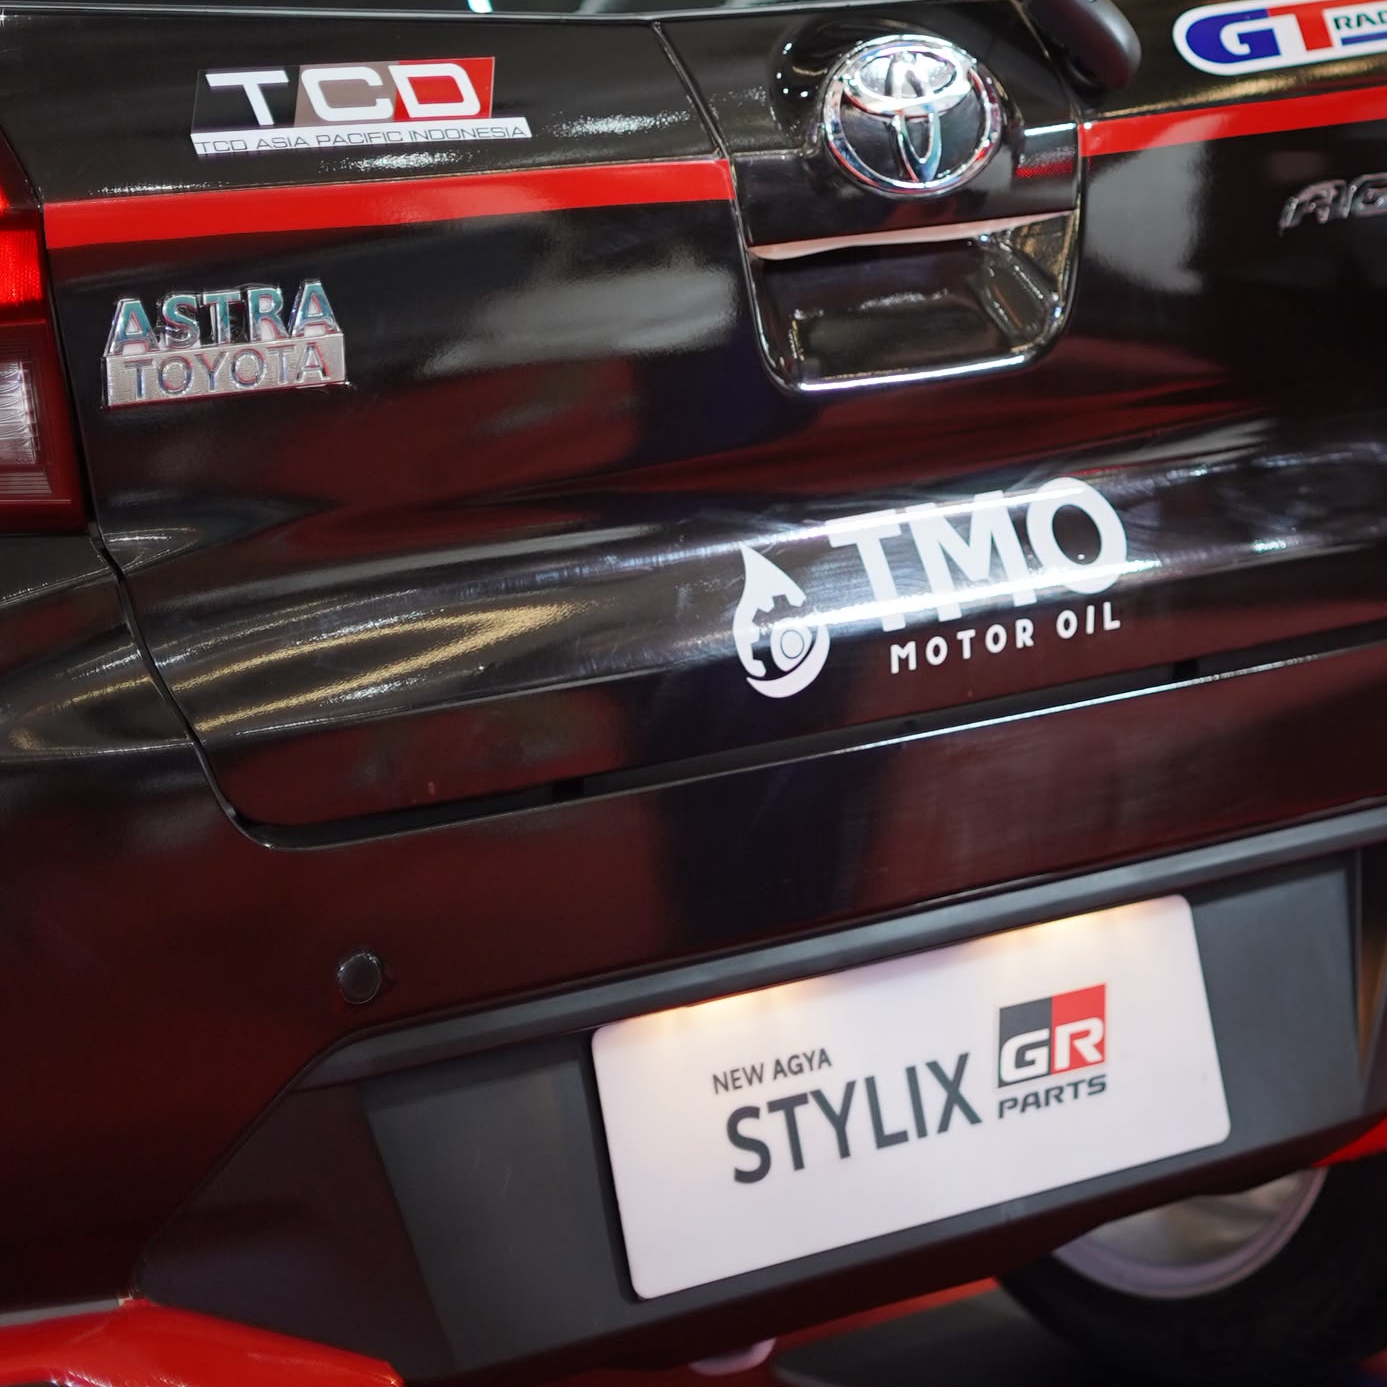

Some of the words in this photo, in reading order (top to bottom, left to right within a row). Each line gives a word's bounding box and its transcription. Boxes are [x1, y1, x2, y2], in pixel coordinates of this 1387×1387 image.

[205, 62, 482, 126] TCD
[195, 140, 248, 154] TCD
[255, 136, 312, 151] ASIA
[315, 130, 404, 147] PACIFIC
[408, 125, 527, 142] INDONESIA
[106, 280, 343, 356] ASTRA
[124, 341, 332, 401] TOYOTA
[826, 476, 1128, 633] TMO
[890, 617, 1035, 674] MOTOR
[1055, 600, 1122, 640] OIL
[711, 1061, 765, 1096] NEW
[772, 1047, 833, 1082] AGYA
[725, 1051, 983, 1185] STYLIX
[999, 1016, 1105, 1084] GR
[997, 1073, 1108, 1120] PARTS
